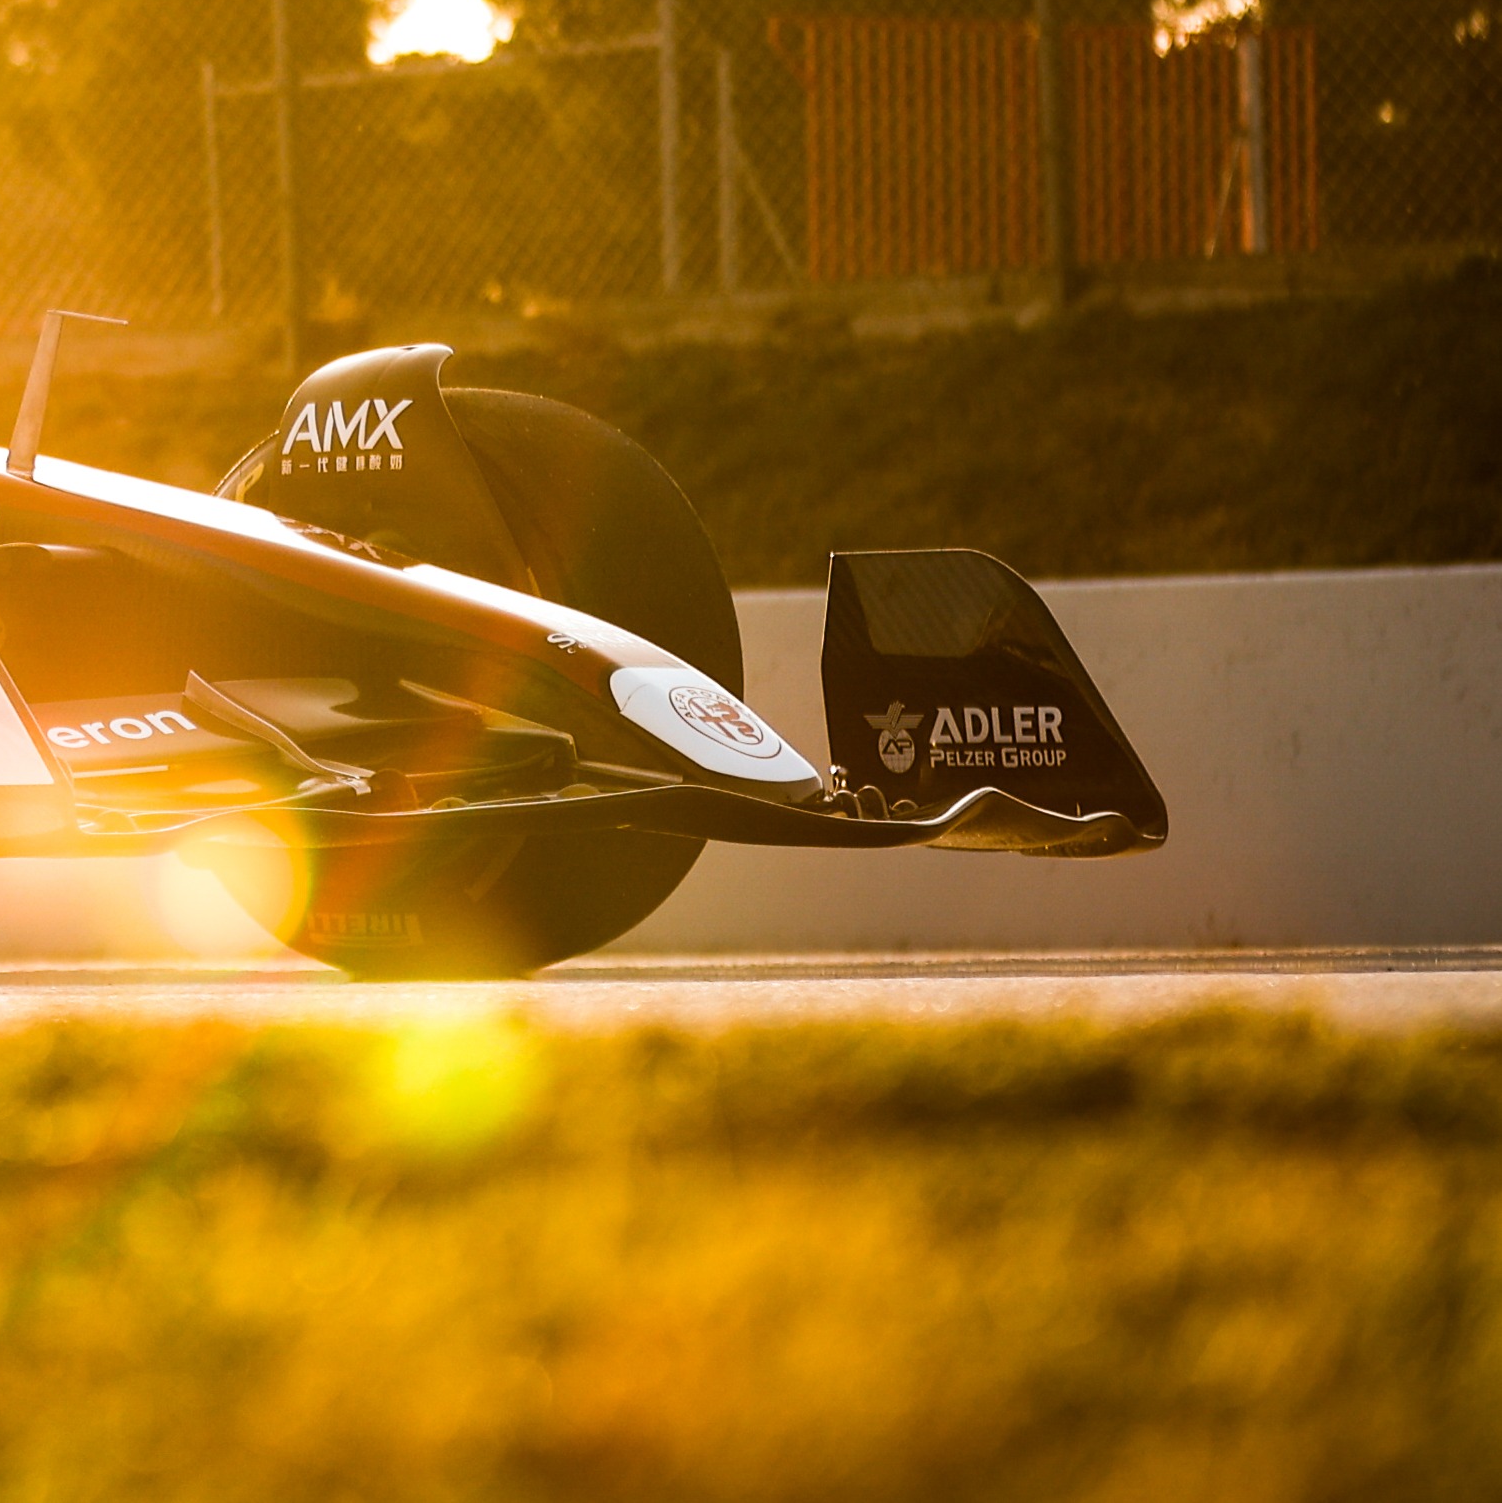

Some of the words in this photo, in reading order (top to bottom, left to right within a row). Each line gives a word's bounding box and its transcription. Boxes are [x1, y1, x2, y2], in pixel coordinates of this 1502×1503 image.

[281, 399, 414, 455] AMX
[929, 706, 1064, 744] ADLER
[929, 749, 995, 769] PELZER
[1001, 747, 1067, 768] GROUP
